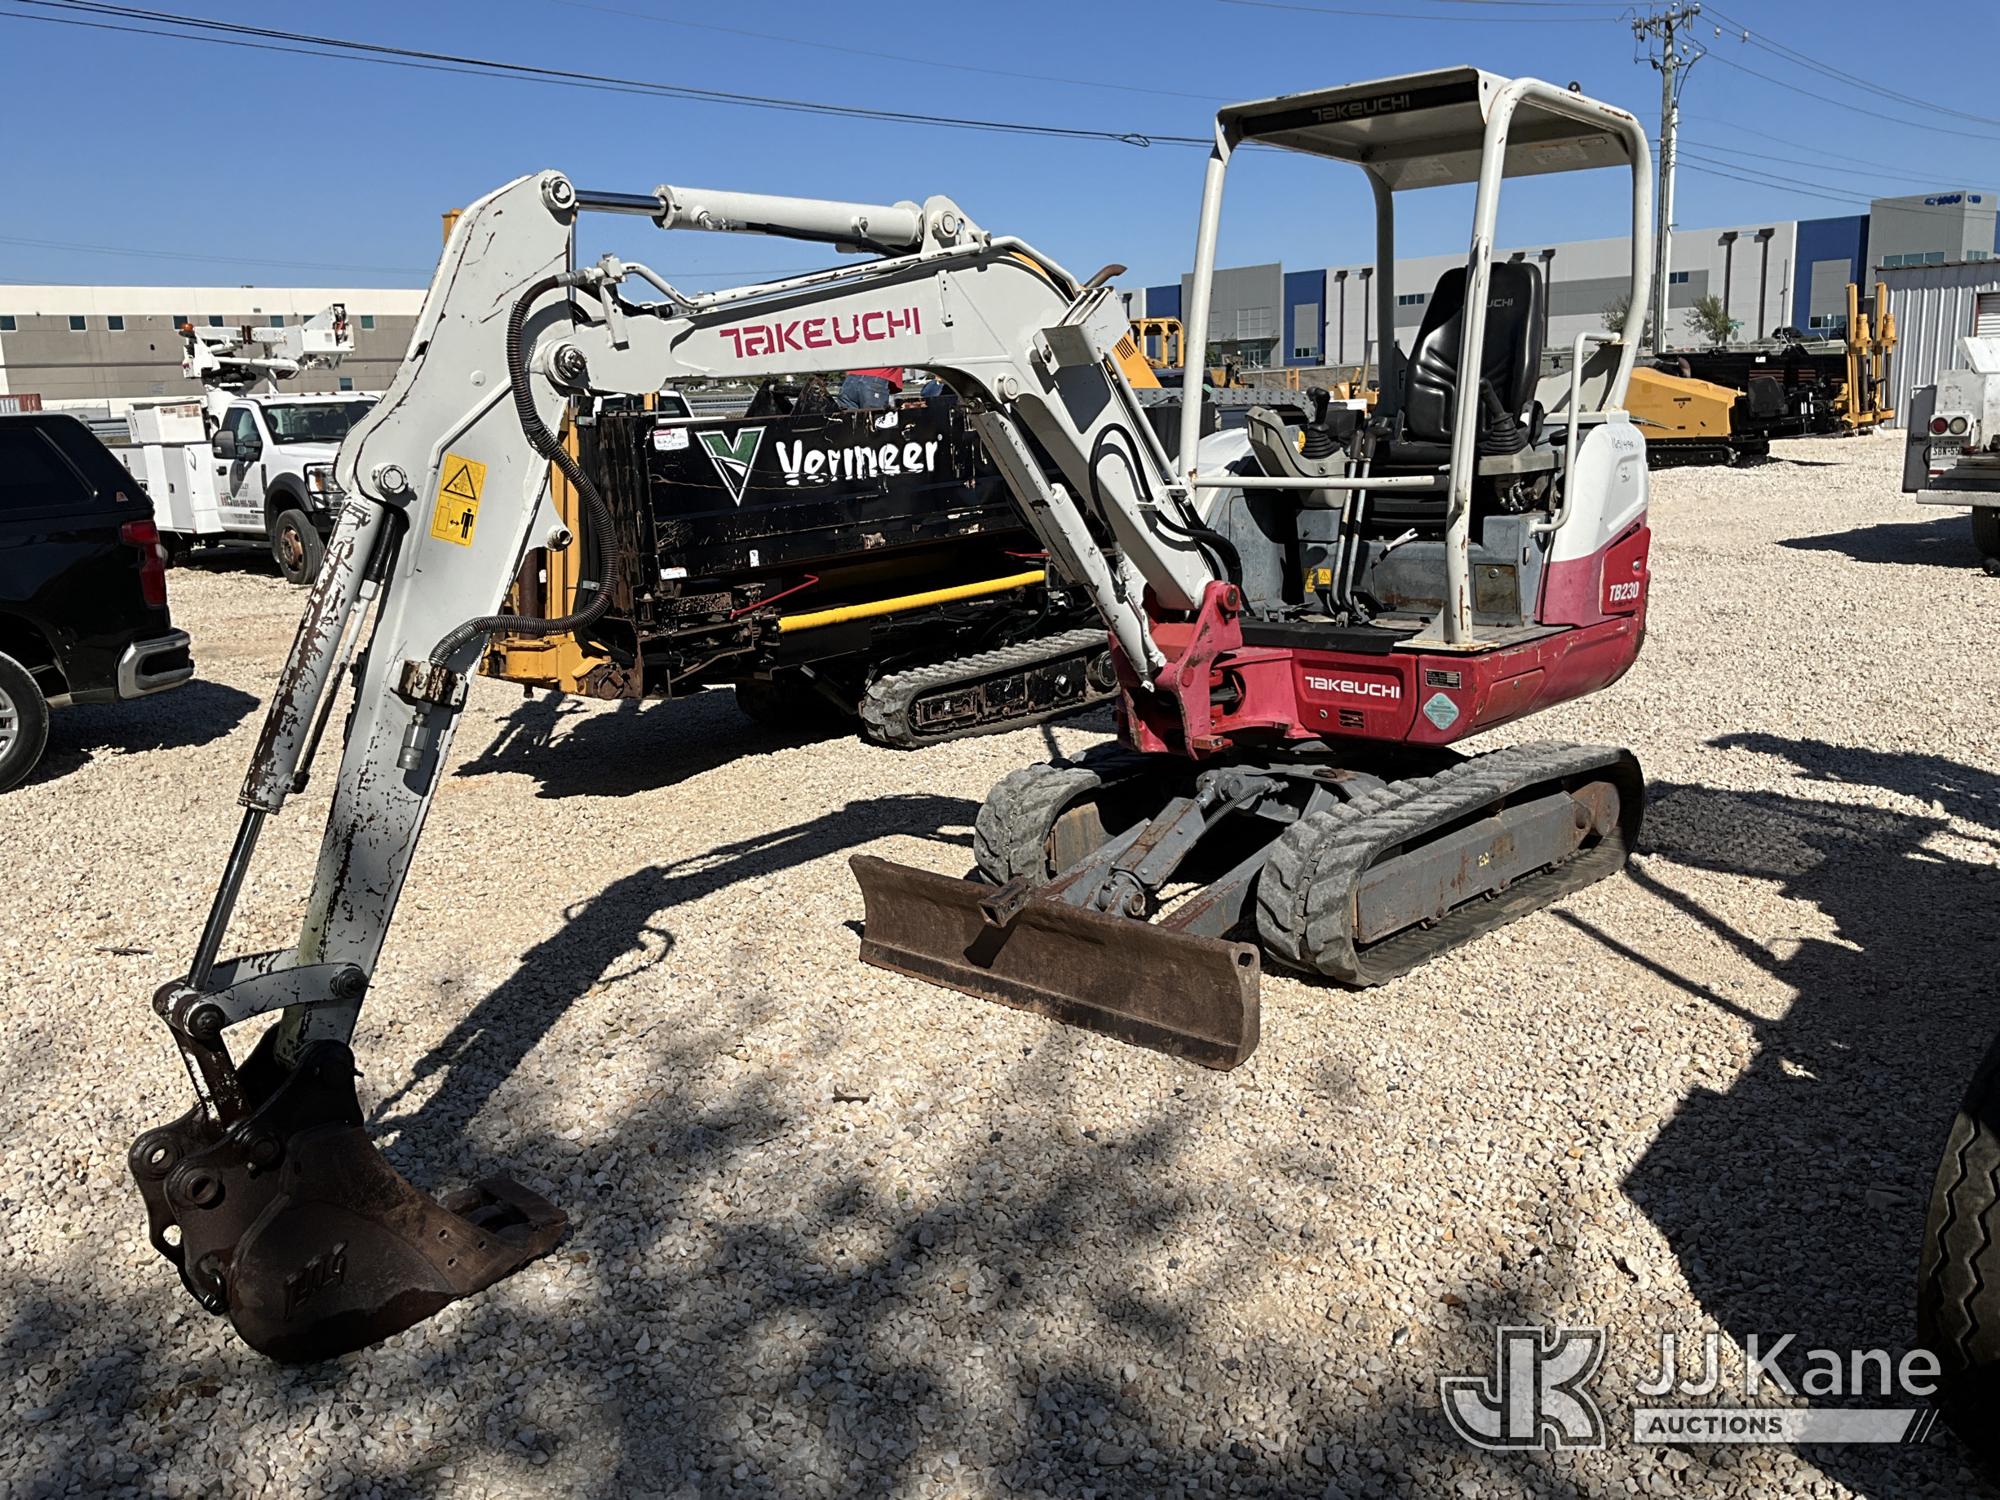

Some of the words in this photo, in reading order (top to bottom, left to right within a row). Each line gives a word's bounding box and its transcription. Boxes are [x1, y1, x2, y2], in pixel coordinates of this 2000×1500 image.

[1311, 94, 1411, 121] TAKEUCHI
[1486, 297, 1514, 308] UCHI
[719, 307, 921, 358] TAKEUCHI
[776, 439, 939, 486] Vermeer
[1609, 581, 1640, 602] TB230
[1304, 676, 1401, 699] TAKEUCHI
